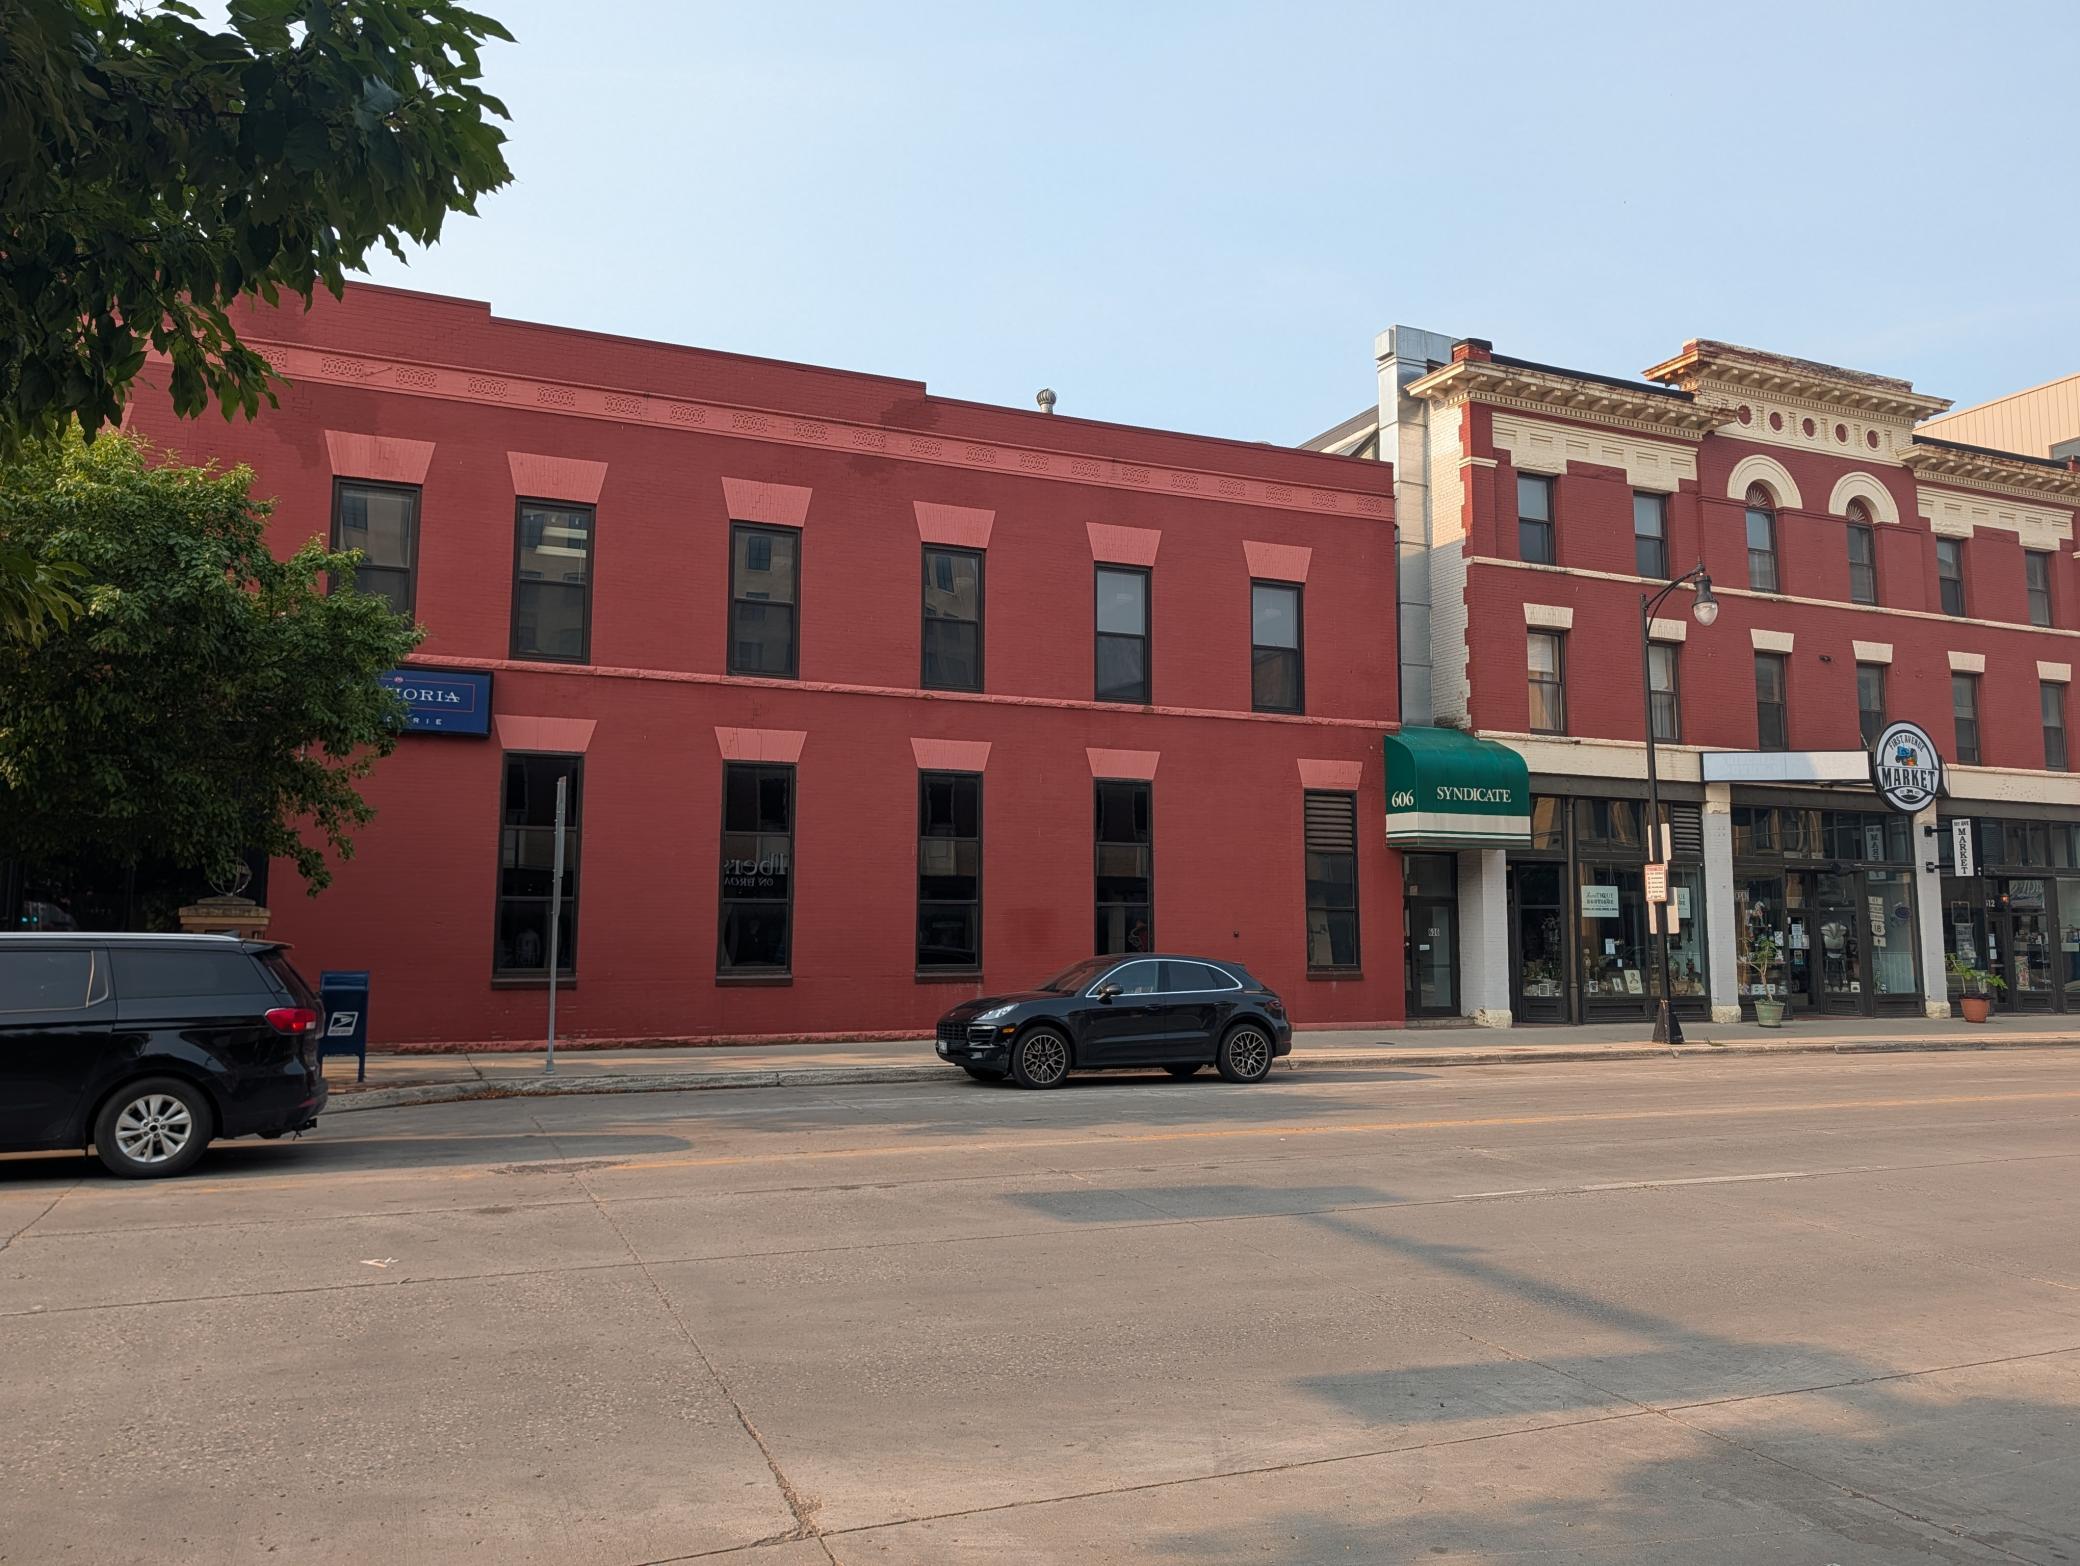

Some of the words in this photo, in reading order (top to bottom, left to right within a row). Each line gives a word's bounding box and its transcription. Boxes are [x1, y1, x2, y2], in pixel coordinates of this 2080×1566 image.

[1888, 734, 1904, 750] FIRST
[1905, 734, 1925, 752] AVENUE
[1881, 767, 1935, 792] MARKET
[1391, 790, 1414, 808] 606
[1436, 786, 1512, 803] SYNDICATE
[1957, 827, 1969, 875] MARKET
